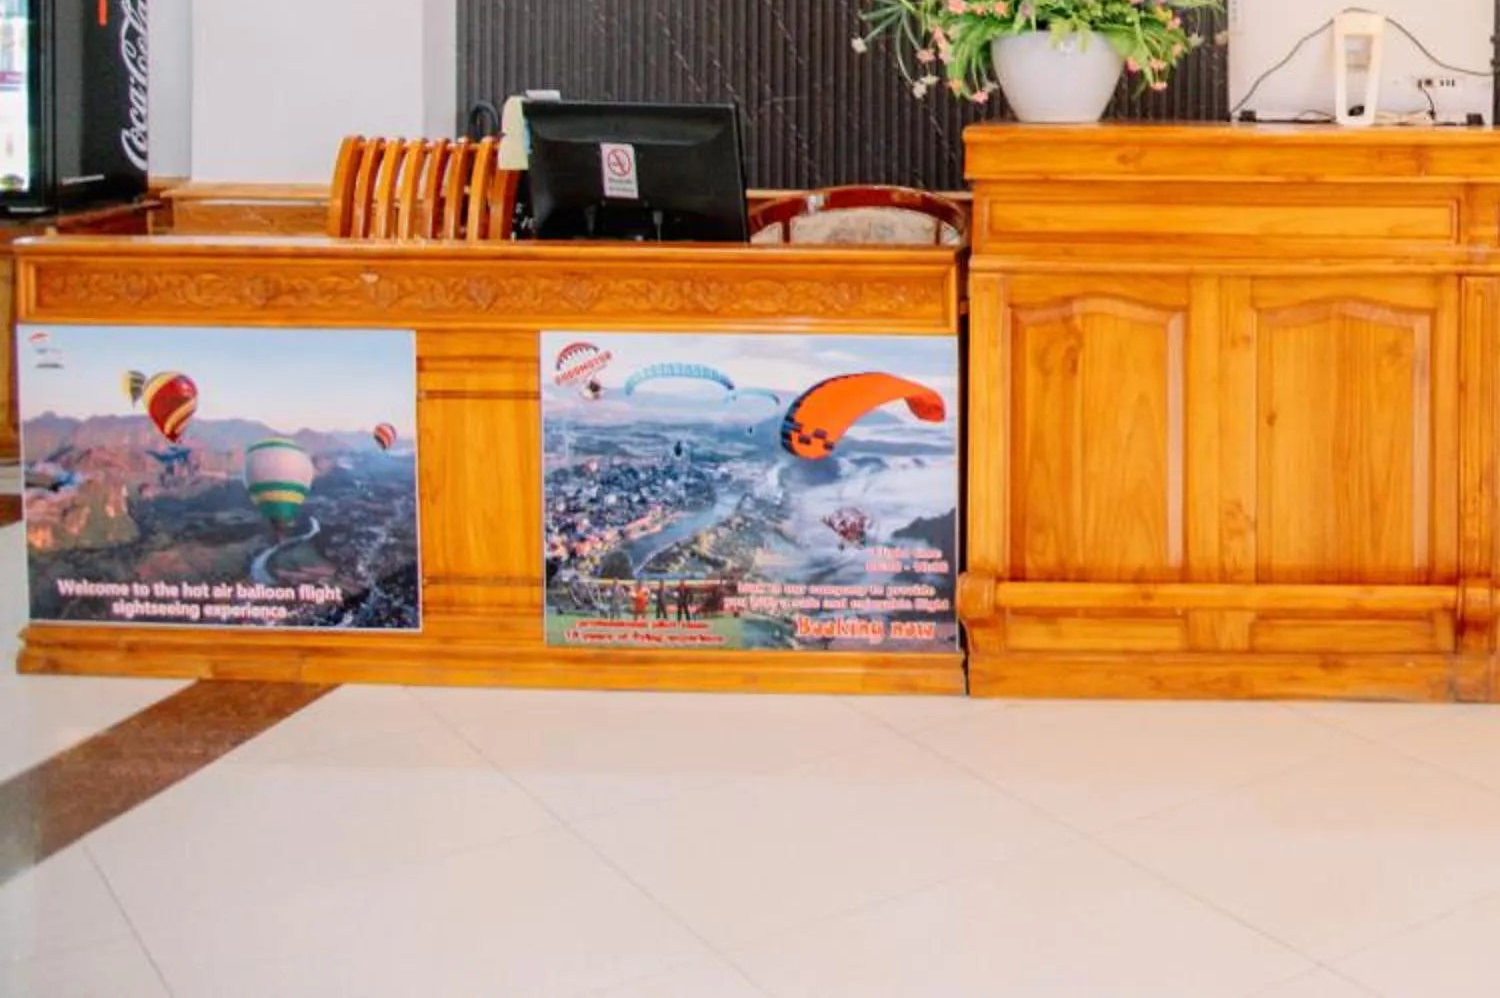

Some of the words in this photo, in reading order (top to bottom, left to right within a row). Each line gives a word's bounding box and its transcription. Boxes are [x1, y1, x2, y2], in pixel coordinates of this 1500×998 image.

[57, 579, 130, 596] Welcome
[132, 582, 150, 597] to
[153, 581, 180, 598] the
[182, 582, 210, 599] hot
[212, 582, 233, 599] air
[236, 582, 296, 600] balloon
[299, 583, 343, 604] flight
[112, 599, 200, 619] sightseeing
[203, 602, 288, 620] experience
[798, 615, 885, 643] Booking
[890, 621, 936, 639] now
